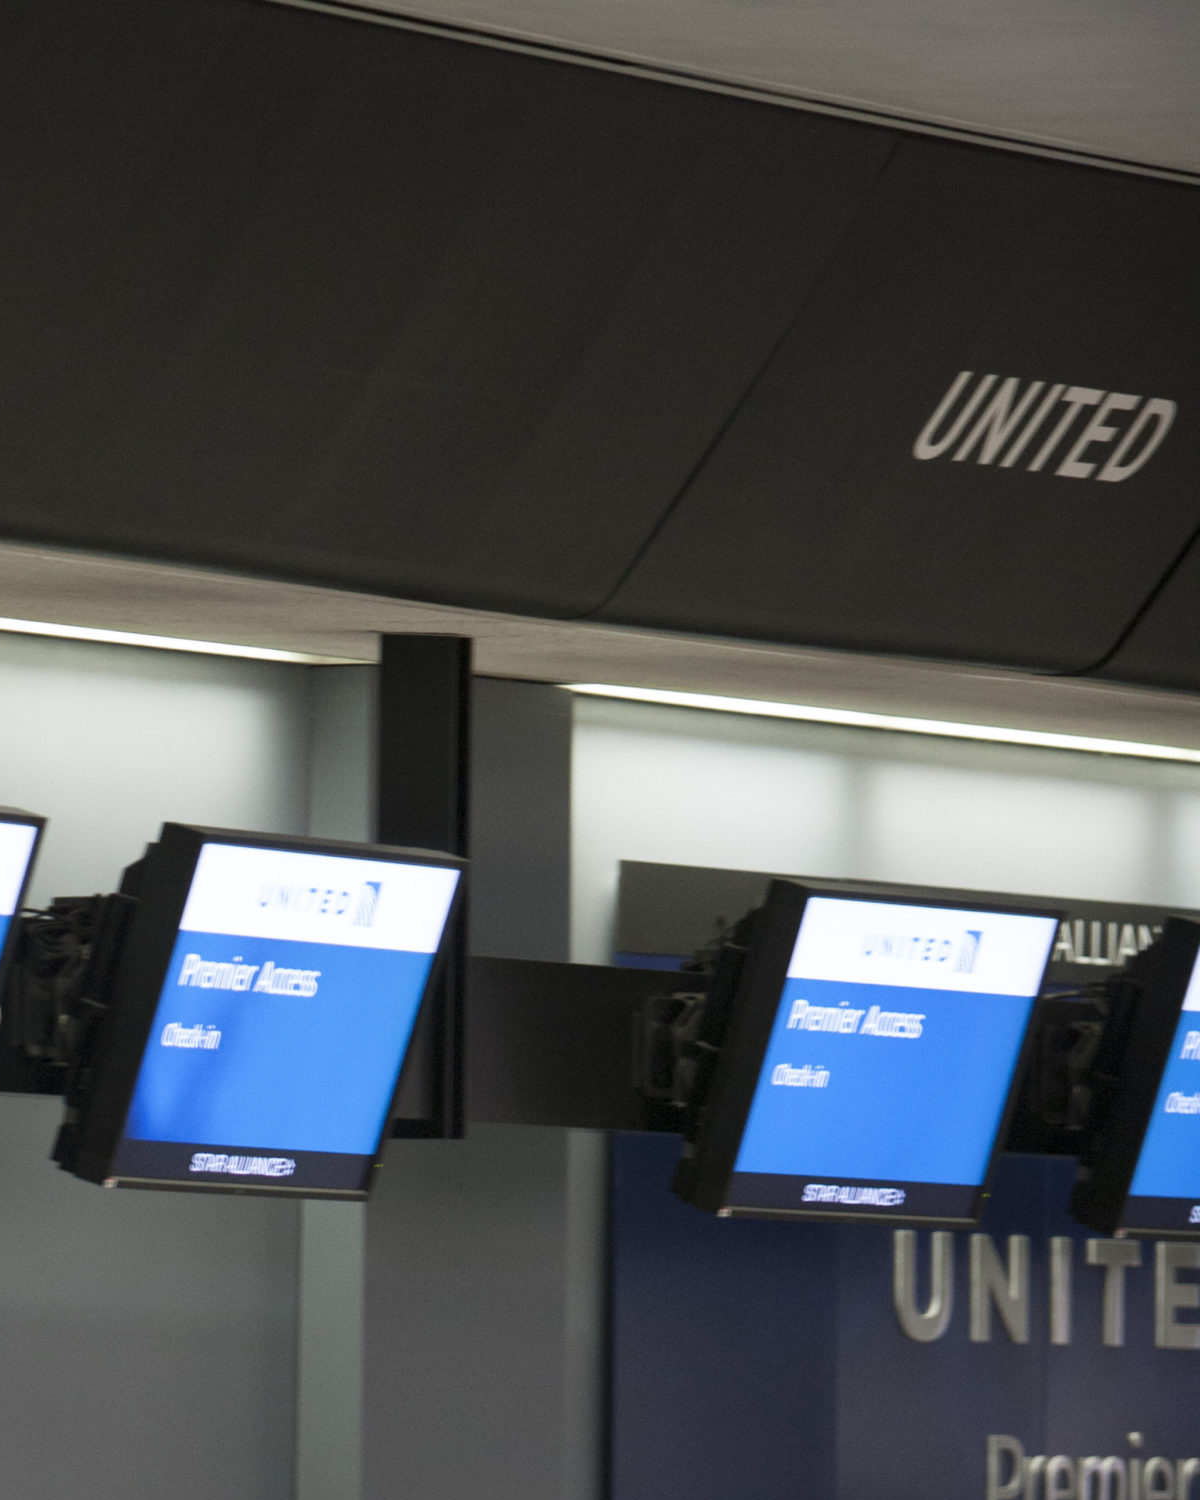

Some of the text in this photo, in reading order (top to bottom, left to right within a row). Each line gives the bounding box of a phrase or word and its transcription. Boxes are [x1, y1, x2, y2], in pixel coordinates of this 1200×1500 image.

[912, 371, 1177, 483] UNITED
[256, 881, 351, 915] UNITED
[861, 931, 952, 963] UNITED
[177, 952, 322, 998] Premier Access
[160, 1021, 222, 1050] Check-in
[786, 998, 927, 1040] Premier Access
[189, 1152, 288, 1177] STAR ALLIANCE
[801, 1183, 898, 1207] STAR ALLIANCE
[893, 1228, 1200, 1349] UNITE
